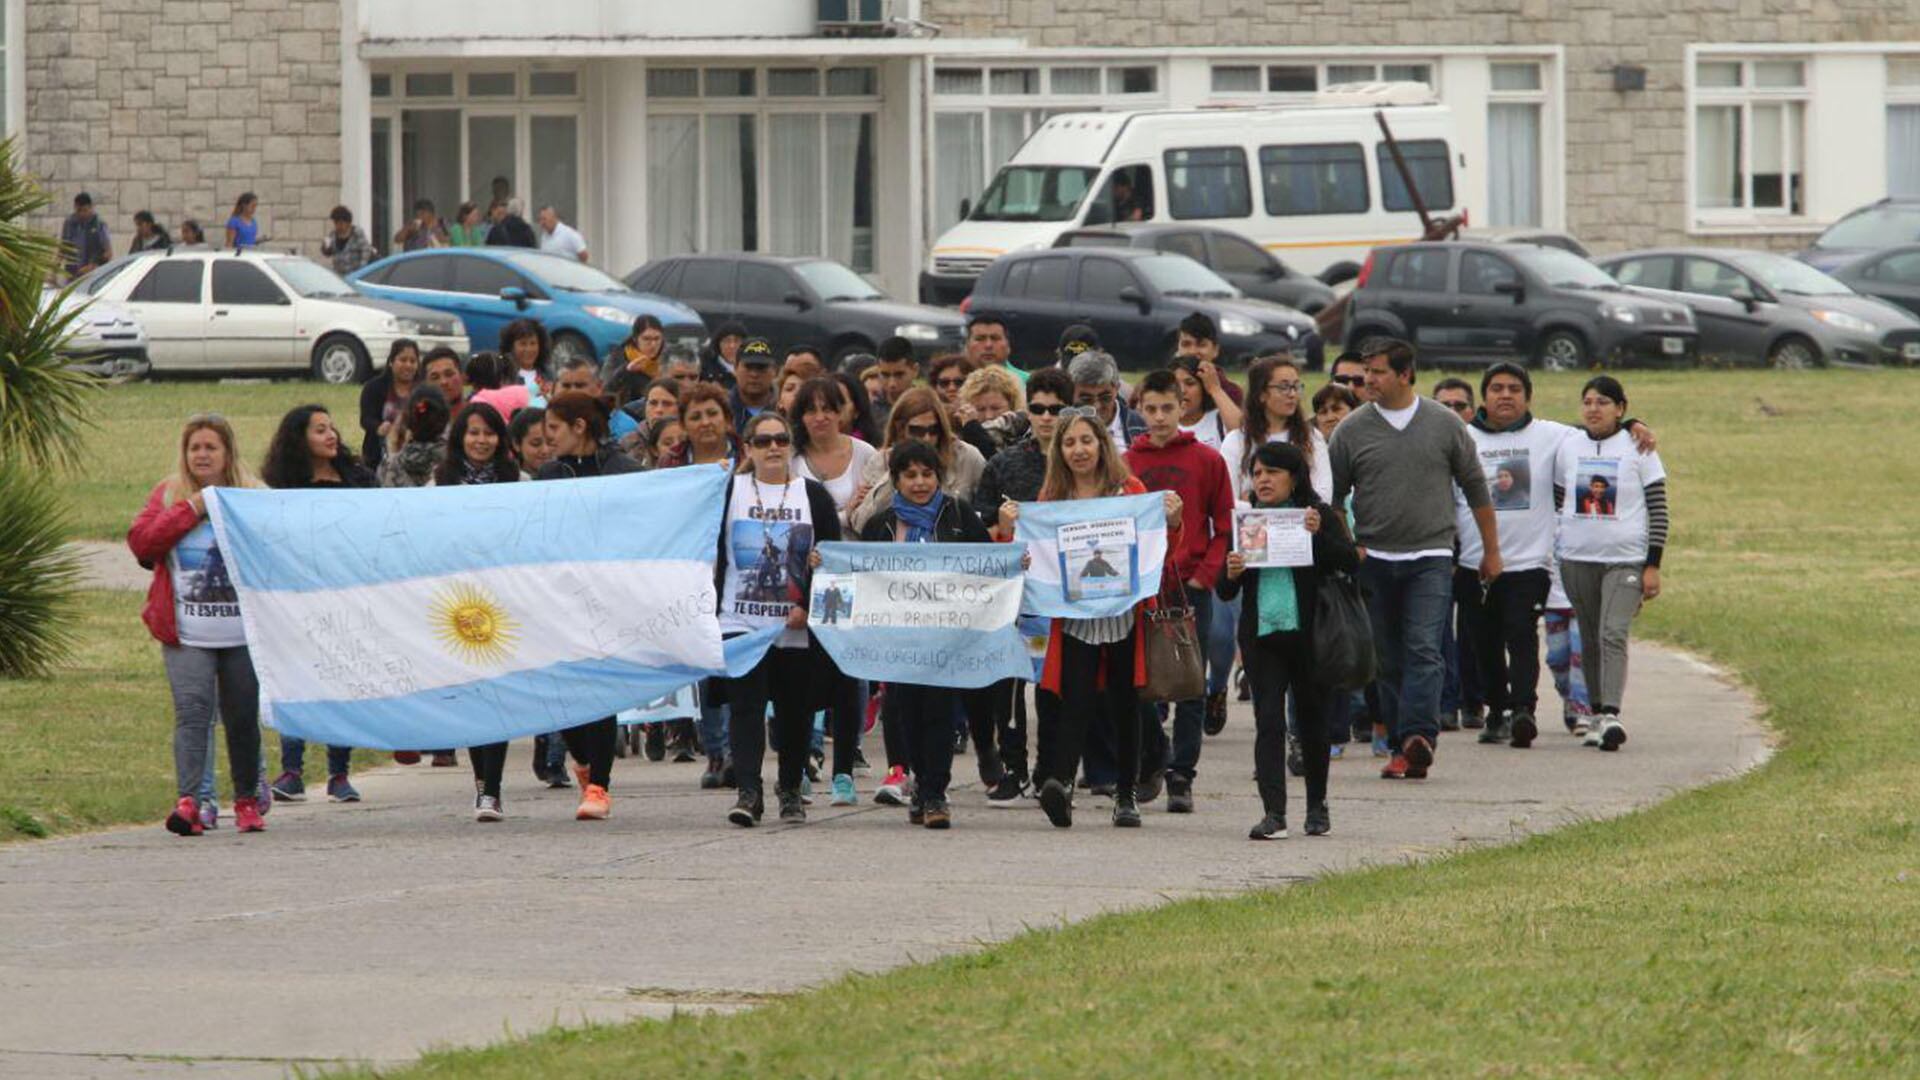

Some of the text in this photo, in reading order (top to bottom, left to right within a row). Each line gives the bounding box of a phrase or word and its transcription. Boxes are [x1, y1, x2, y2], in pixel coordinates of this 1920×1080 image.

[748, 505, 802, 521] GABI
[849, 555, 927, 573] LEANDRO
[887, 581, 994, 604] CISNEROS
[184, 603, 195, 617] TE
[735, 601, 797, 617] TE ESPERA
[904, 611, 972, 627] PRIMERO
[885, 649, 949, 669] ORGULLO
